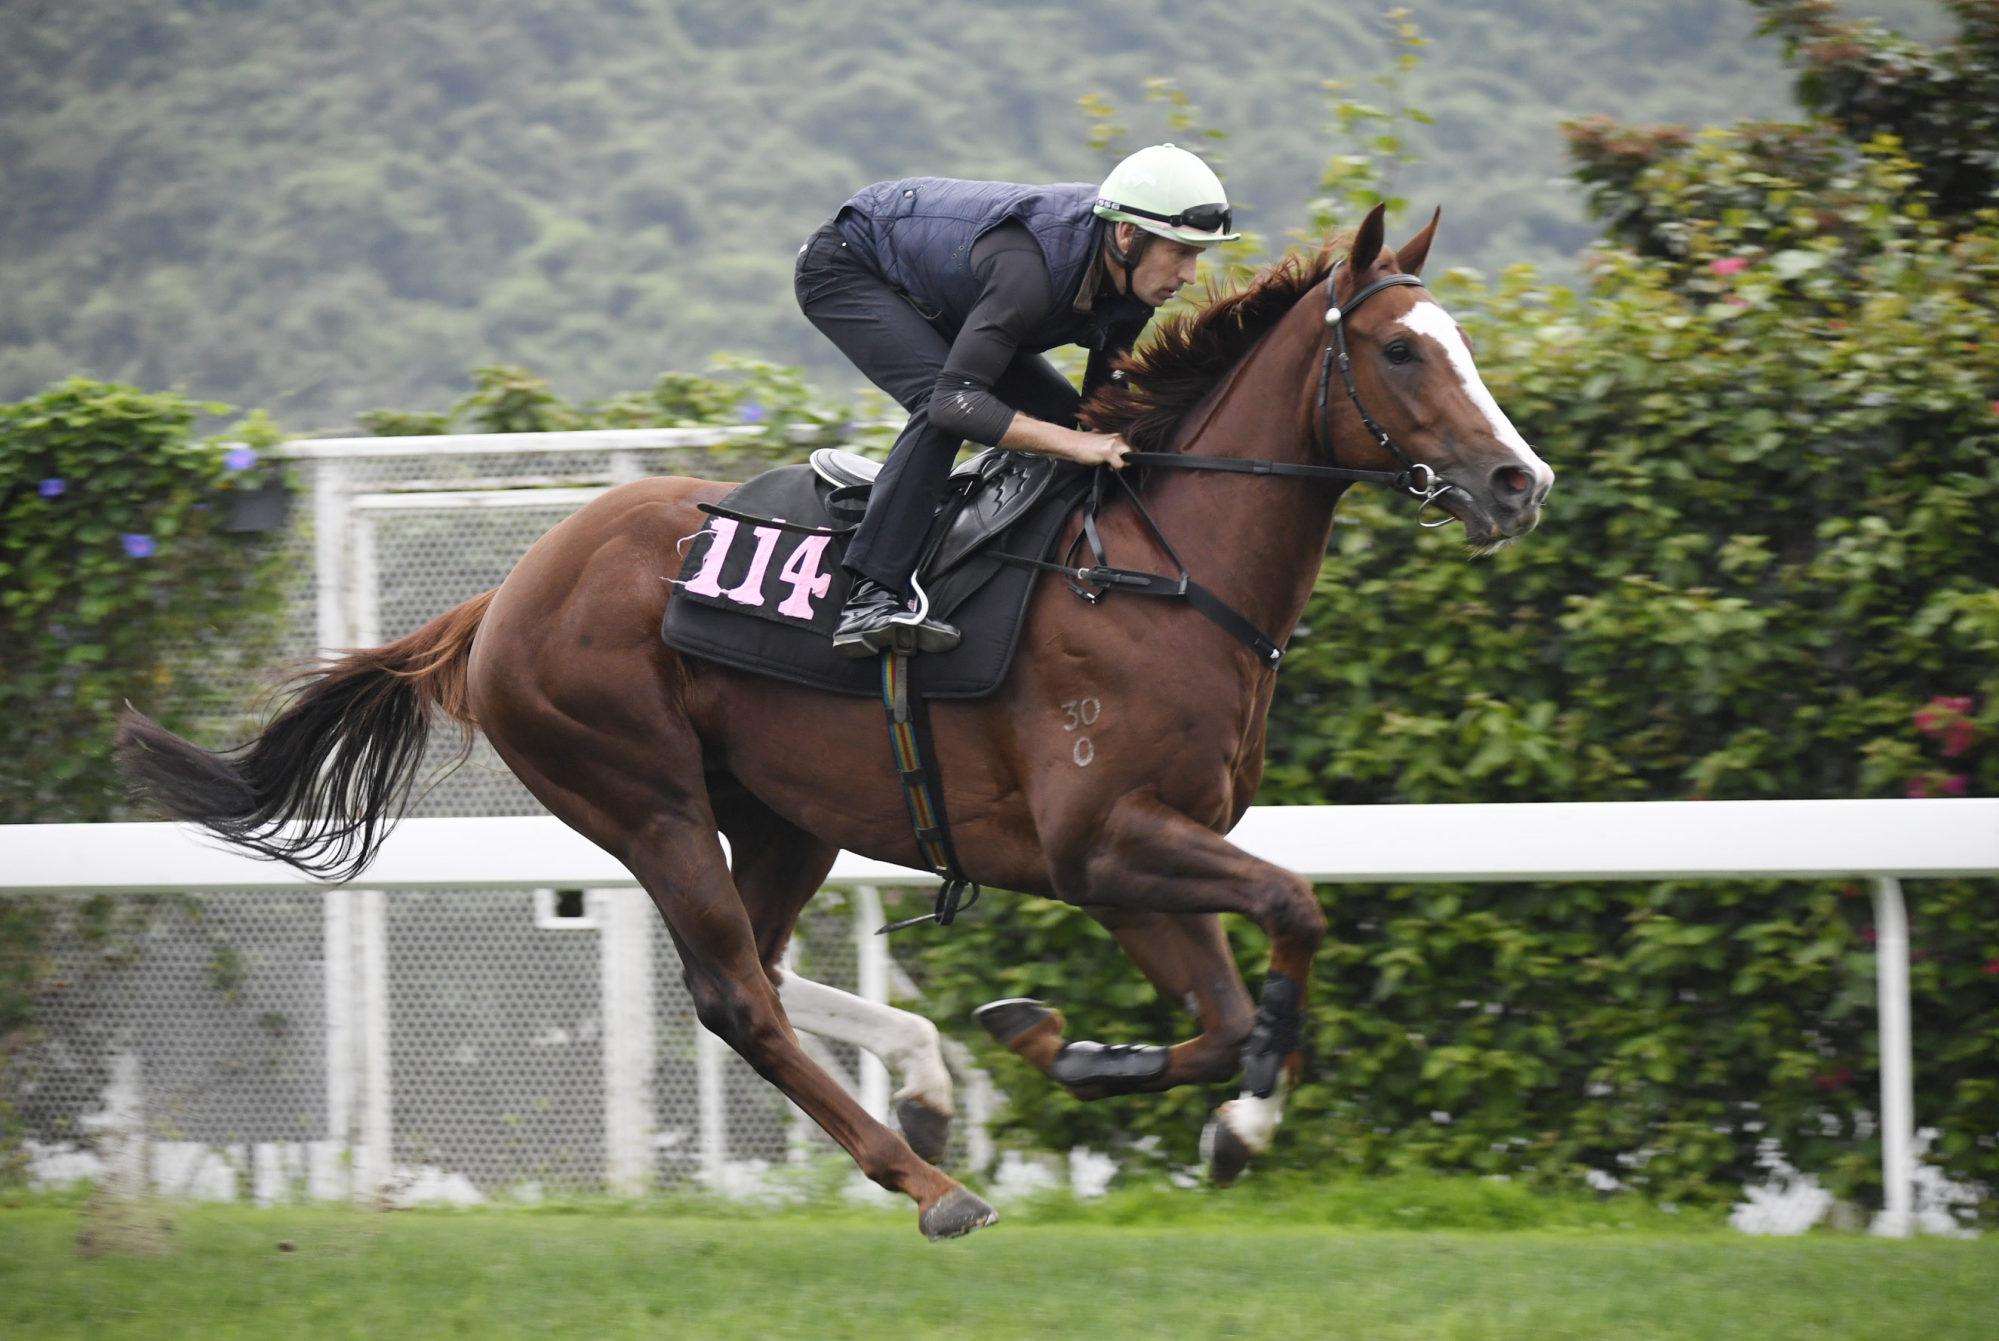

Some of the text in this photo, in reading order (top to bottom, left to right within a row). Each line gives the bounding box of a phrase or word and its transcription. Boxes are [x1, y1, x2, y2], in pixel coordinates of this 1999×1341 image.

[684, 517, 833, 620] 114
[1061, 697, 1101, 731] 30
[1073, 737, 1095, 767] 0
